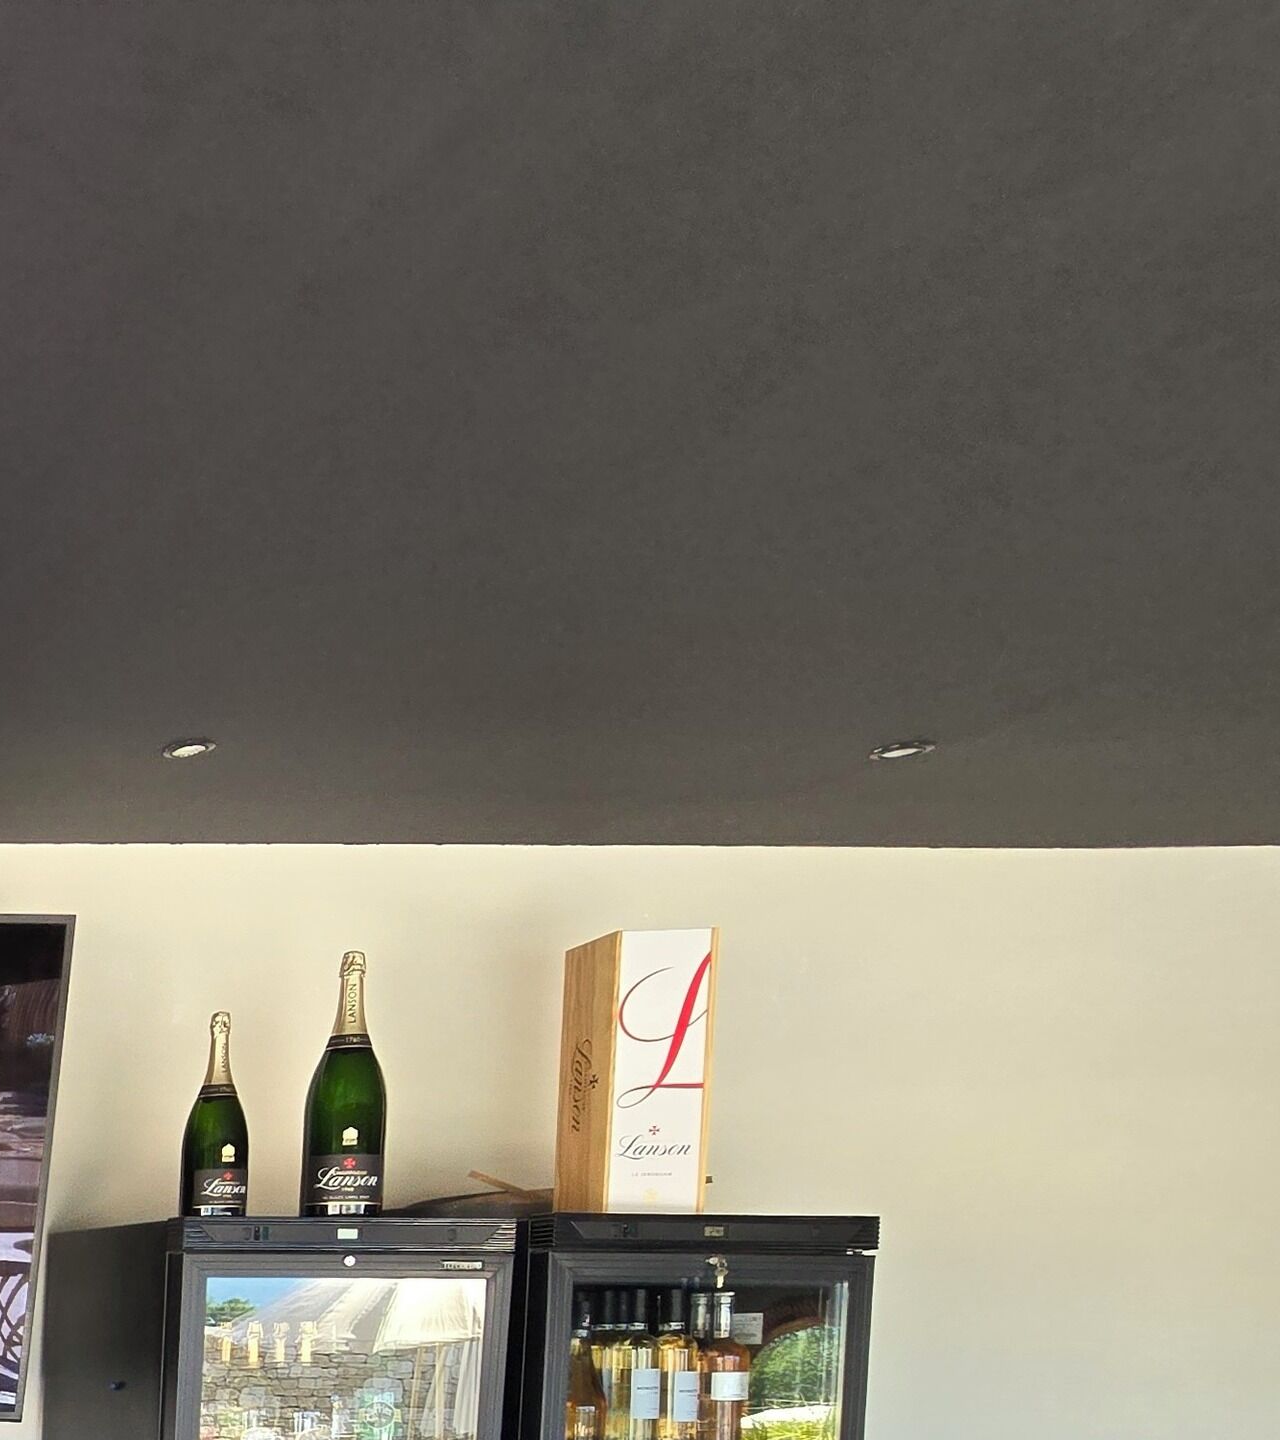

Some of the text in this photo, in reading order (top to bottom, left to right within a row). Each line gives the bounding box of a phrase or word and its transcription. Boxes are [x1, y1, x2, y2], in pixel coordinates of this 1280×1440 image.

[347, 983, 357, 1024] LANSON
[569, 1038, 593, 1133] Lanson
[617, 1134, 691, 1161] Lanson
[313, 1166, 378, 1191] Lanson
